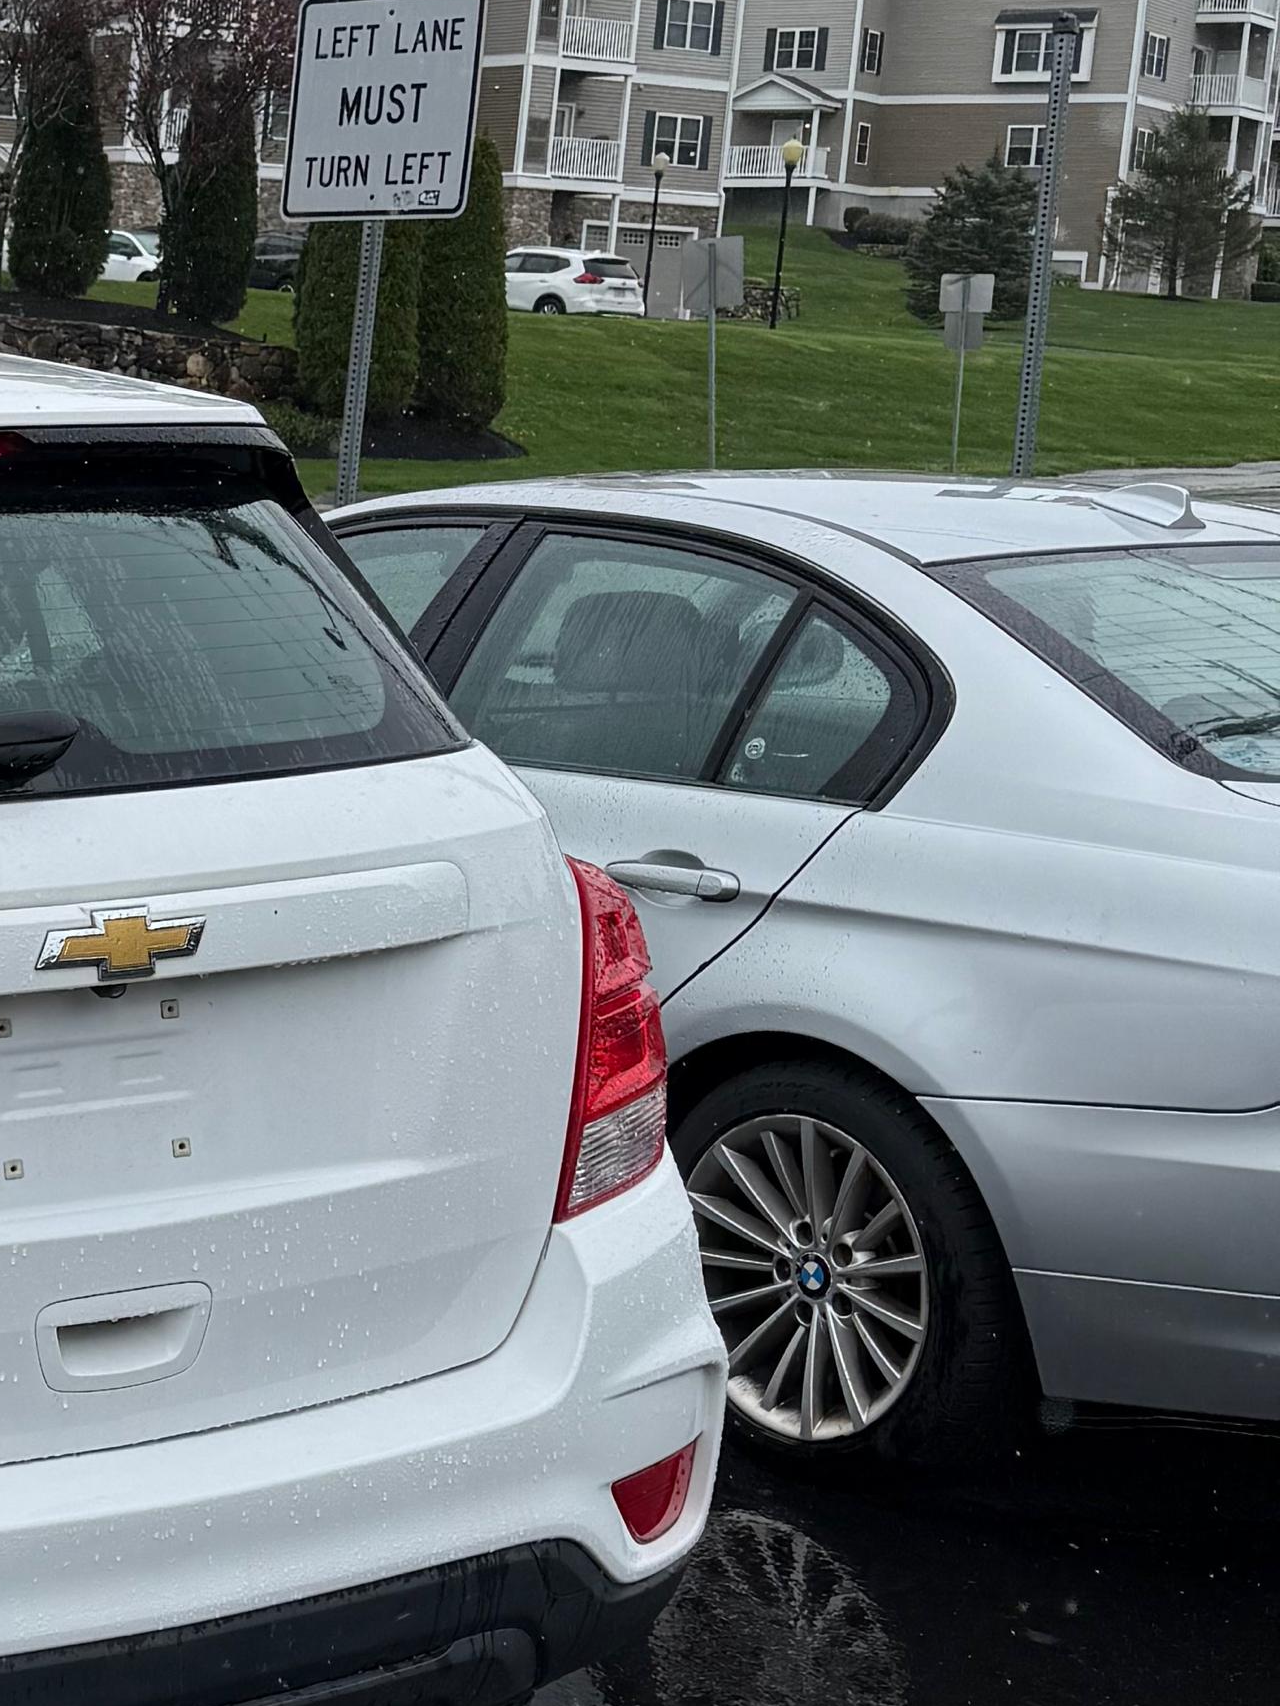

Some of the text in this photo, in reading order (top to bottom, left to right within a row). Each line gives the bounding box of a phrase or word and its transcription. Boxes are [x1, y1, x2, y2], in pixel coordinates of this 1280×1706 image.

[315, 18, 465, 59] LEFT LANE
[339, 83, 427, 126] MUST
[305, 152, 451, 188] TURN LEFT
